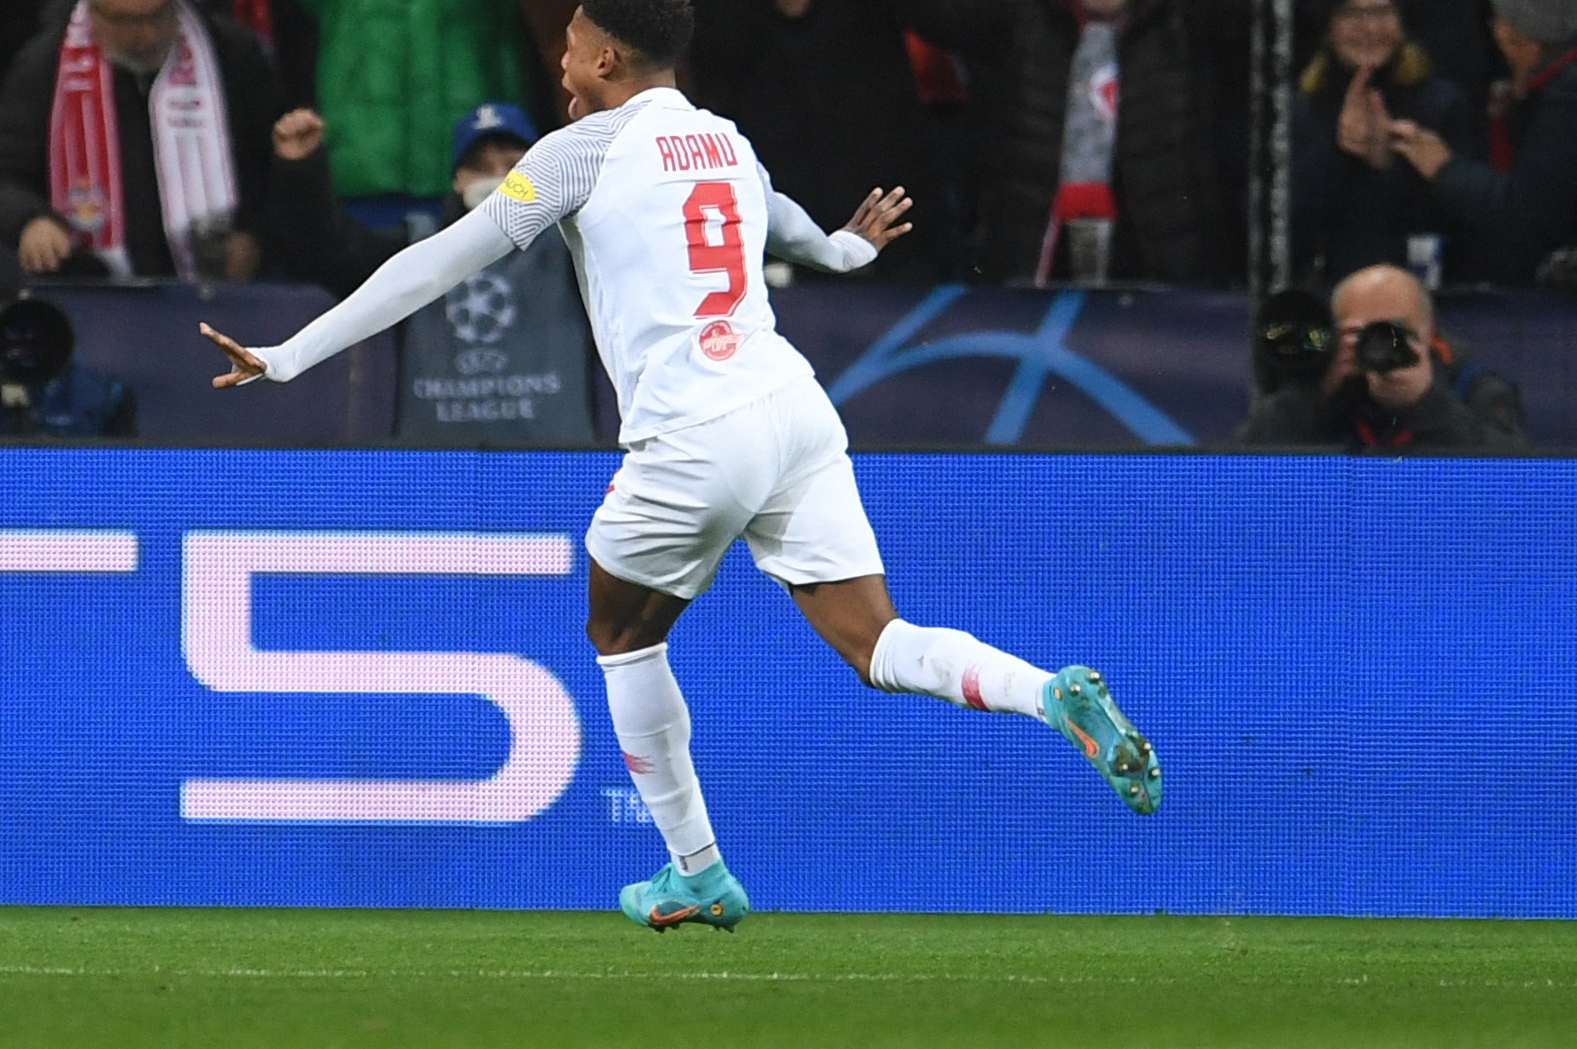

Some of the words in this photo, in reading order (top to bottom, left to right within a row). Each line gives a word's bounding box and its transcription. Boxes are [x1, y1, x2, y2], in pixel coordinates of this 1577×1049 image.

[655, 132, 739, 172] ADAMU
[682, 182, 748, 319] 9
[413, 372, 562, 399] CHAMPIONS
[436, 398, 535, 423] LEAGUE
